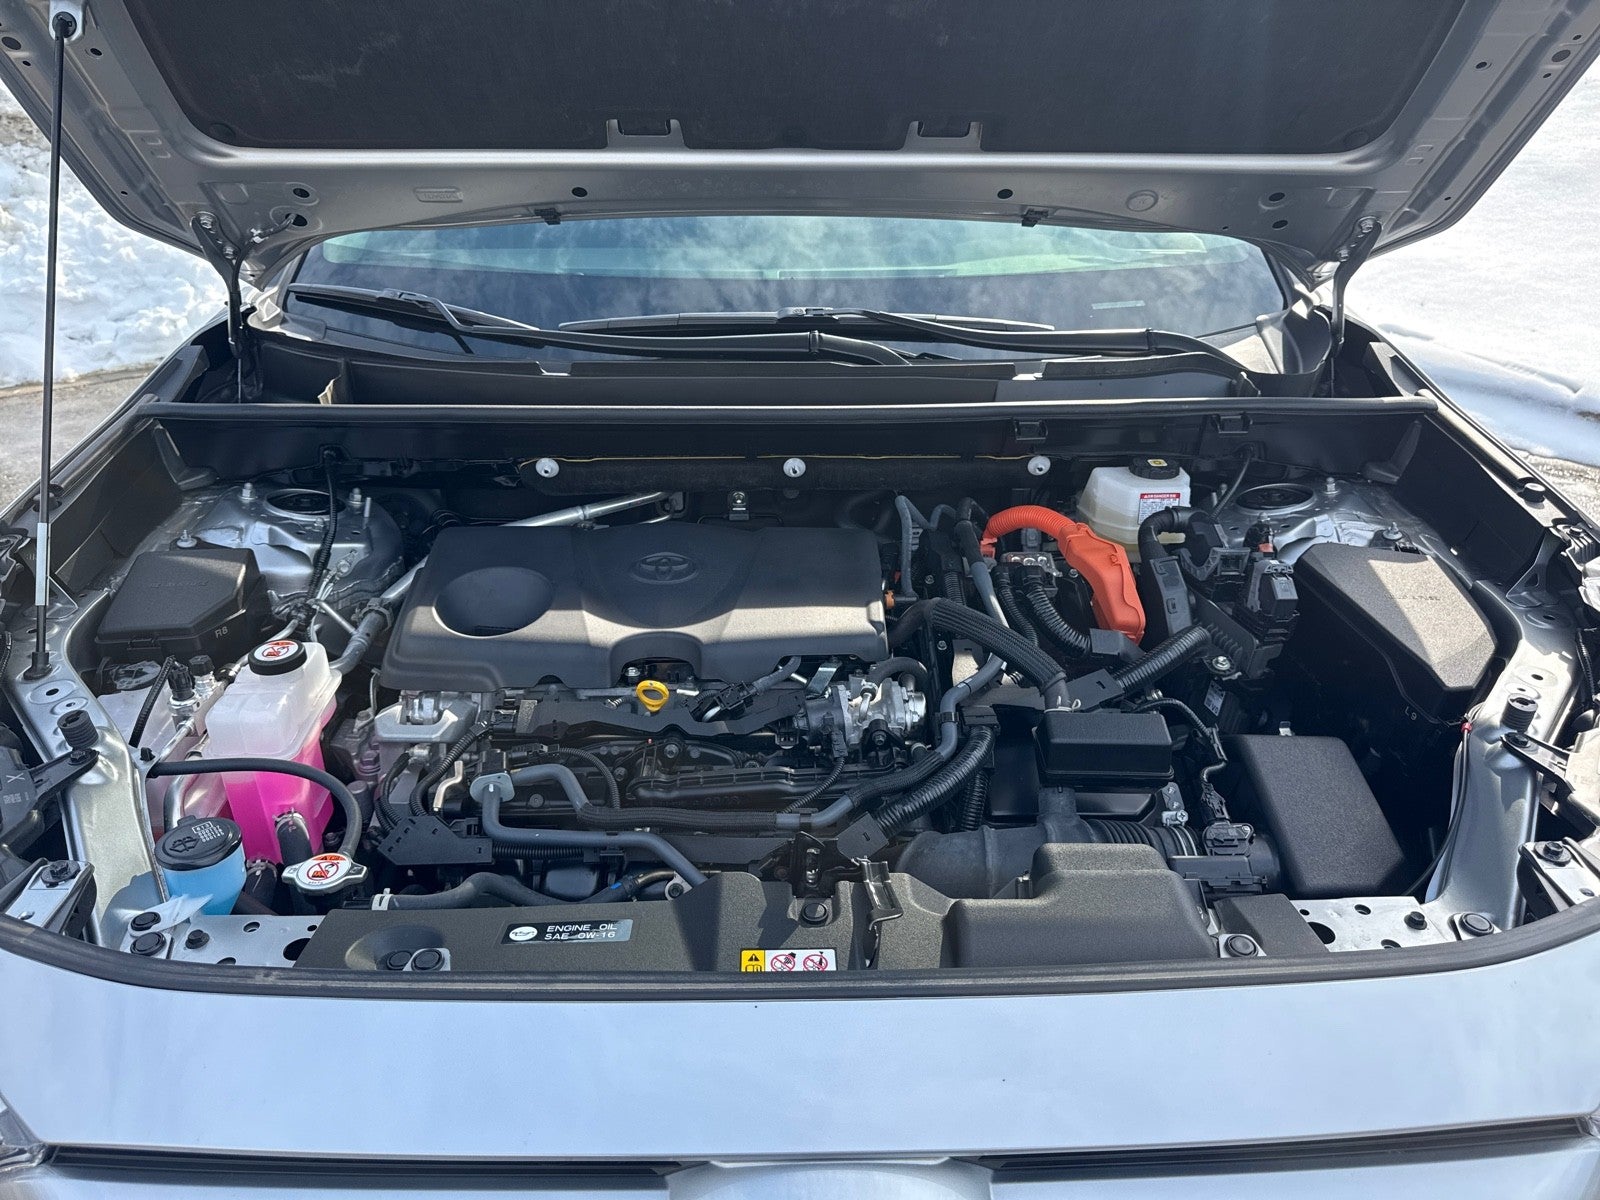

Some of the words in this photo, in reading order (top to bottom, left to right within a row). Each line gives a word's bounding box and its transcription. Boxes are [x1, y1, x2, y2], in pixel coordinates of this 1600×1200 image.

[214, 625, 229, 639] R8
[546, 924, 592, 933] ENGINE
[599, 923, 618, 931] OIL
[544, 932, 570, 940] SAE
